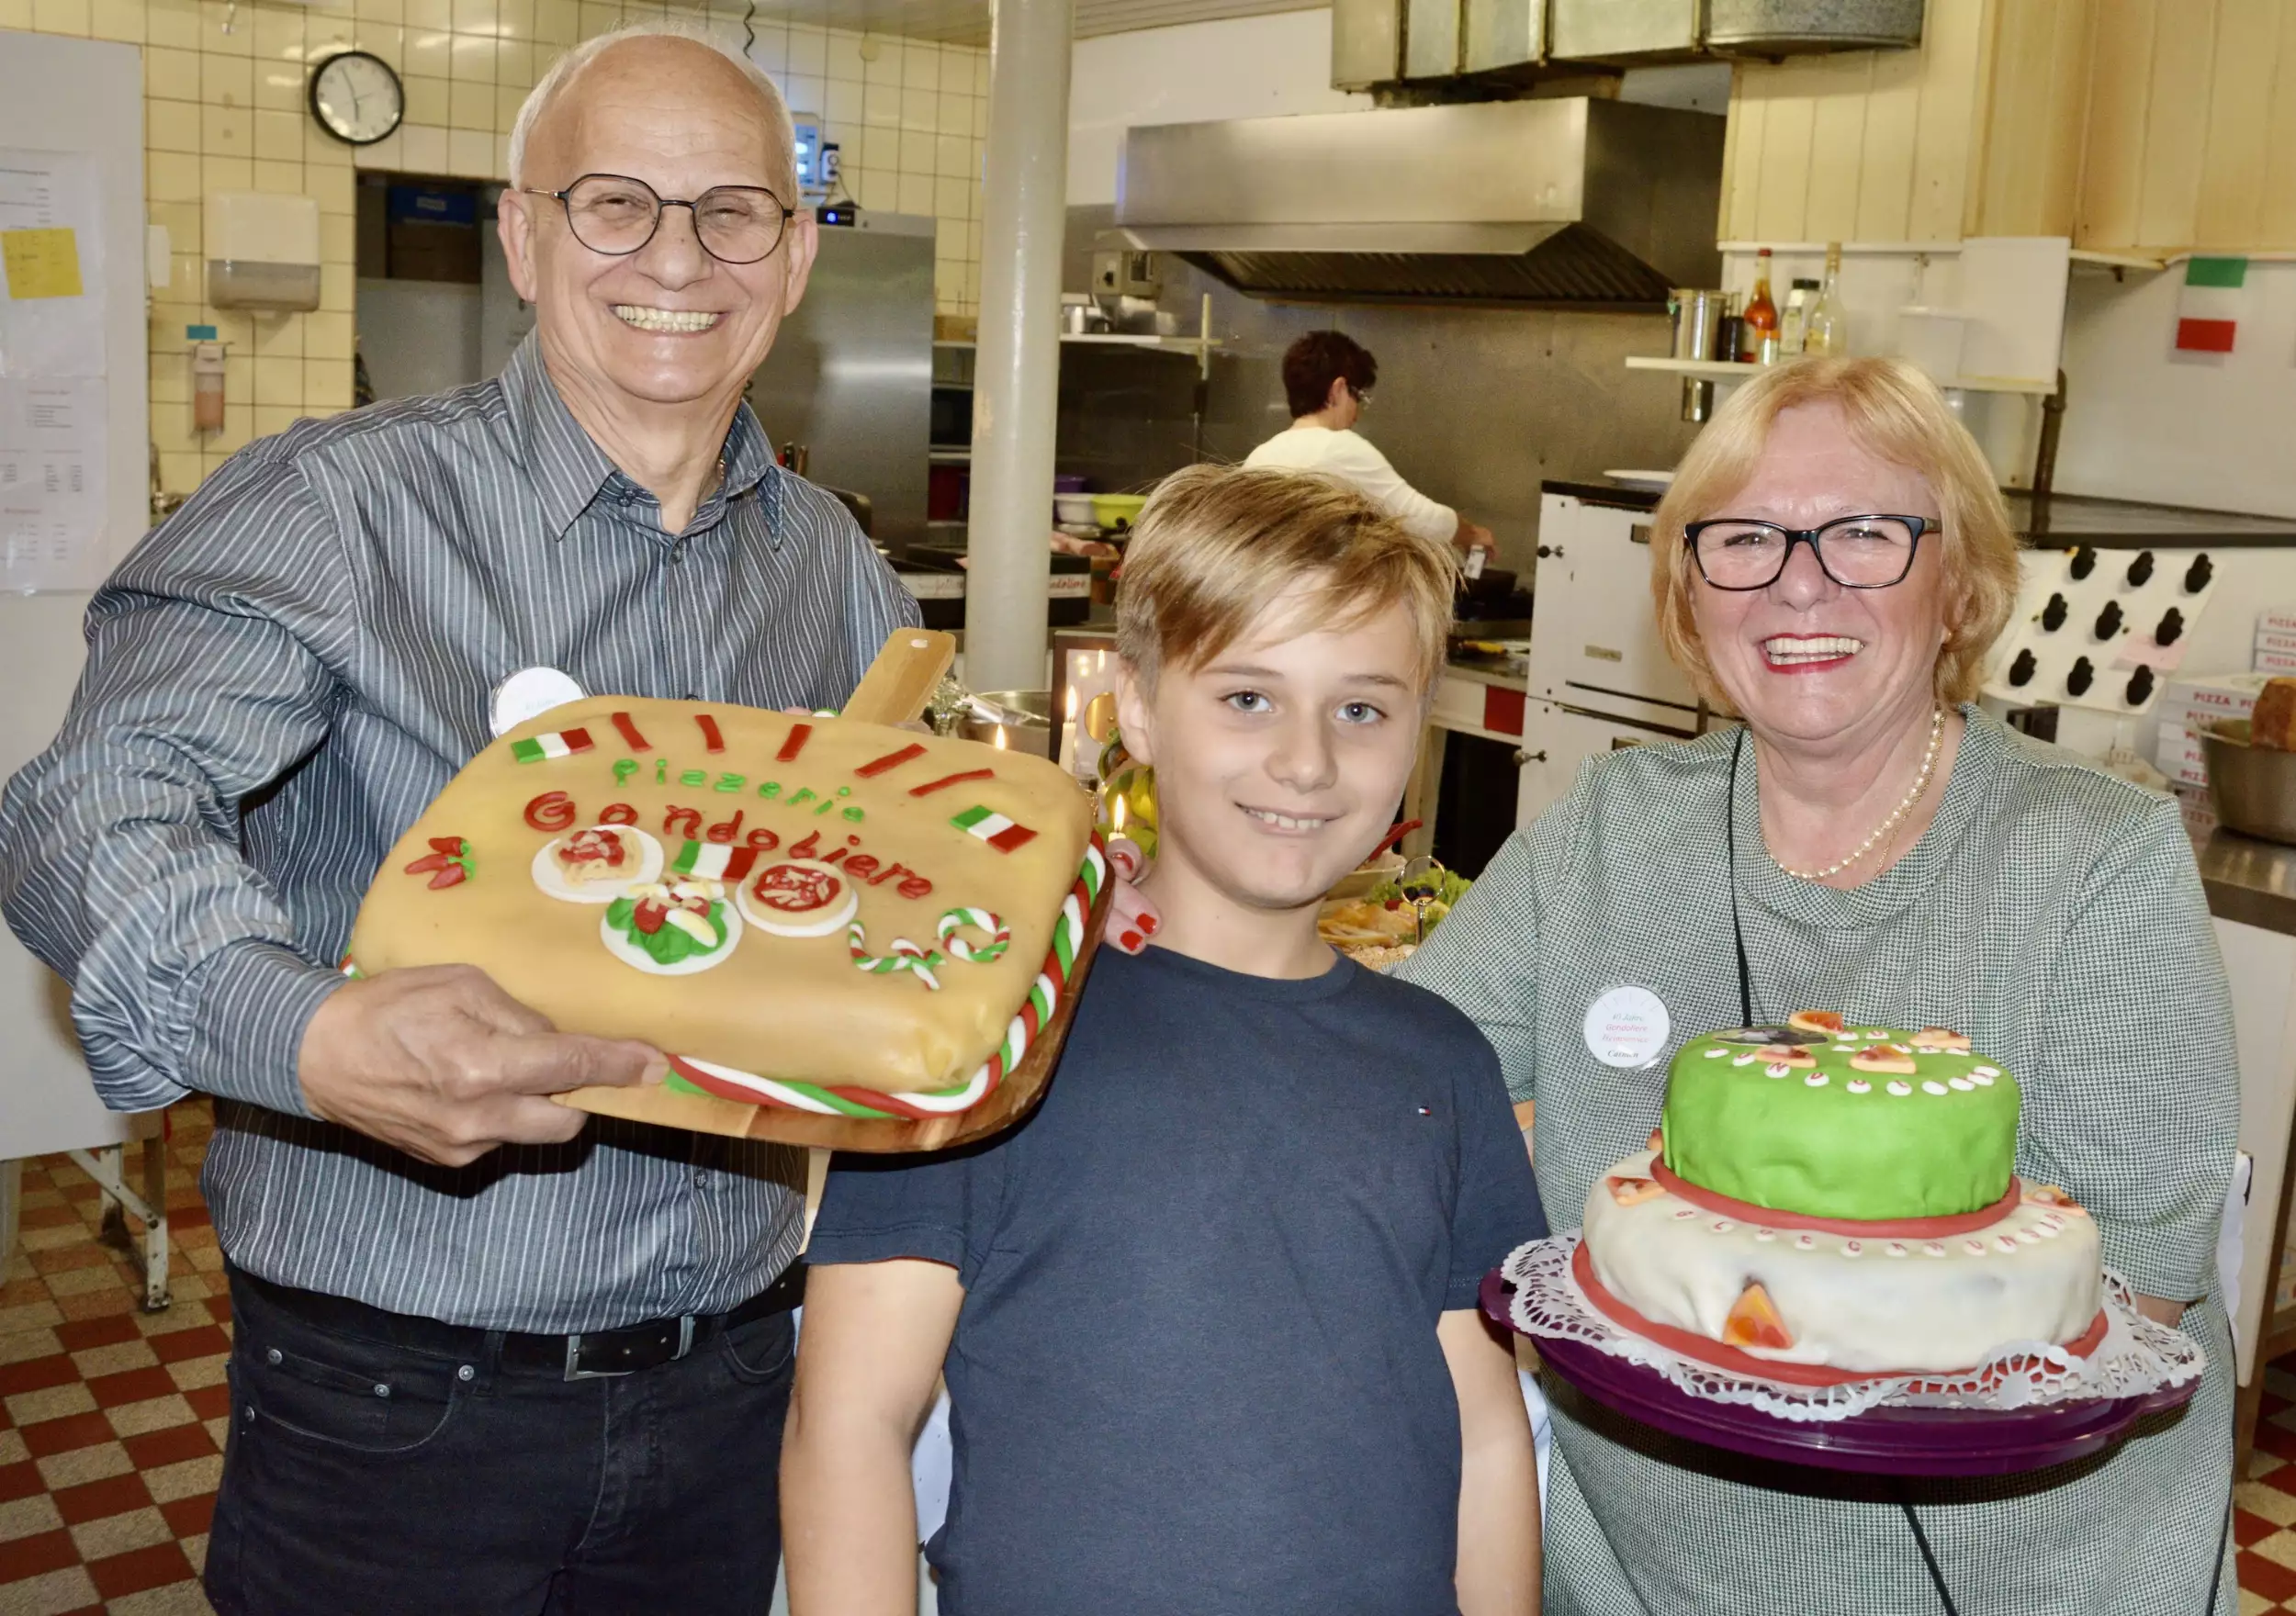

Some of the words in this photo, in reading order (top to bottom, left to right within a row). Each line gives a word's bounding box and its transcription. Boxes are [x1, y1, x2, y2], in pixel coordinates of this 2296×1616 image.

[2194, 691, 2231, 706] PIZZA
[613, 758, 865, 823] Pizzeria
[523, 791, 933, 899] Gondoliere
[848, 907, 1011, 991] 40
